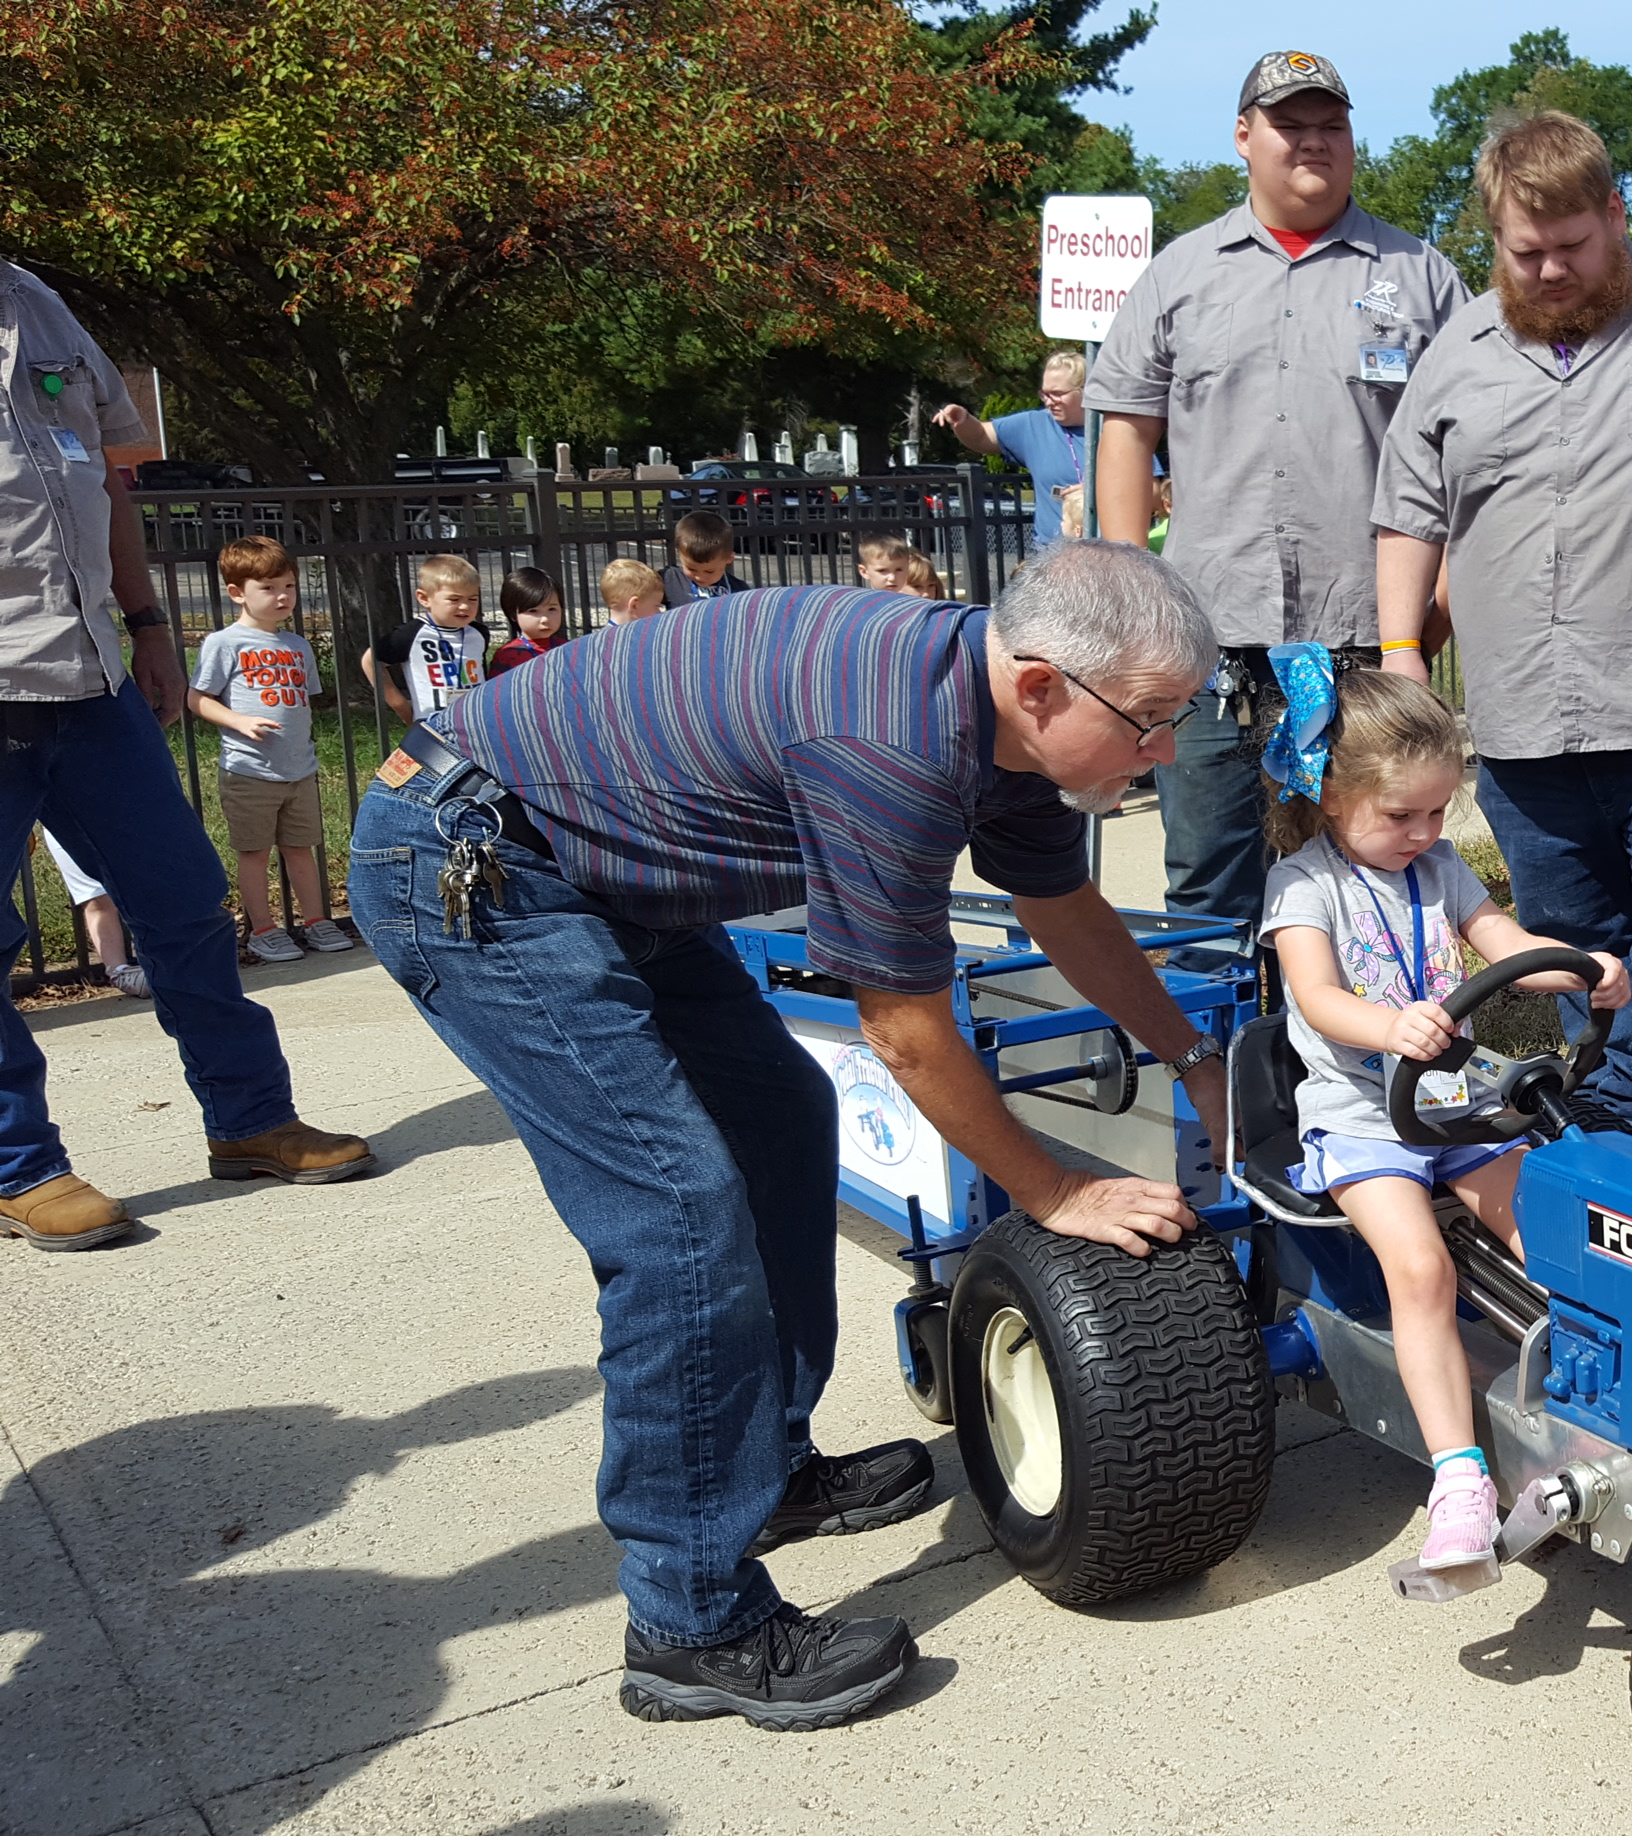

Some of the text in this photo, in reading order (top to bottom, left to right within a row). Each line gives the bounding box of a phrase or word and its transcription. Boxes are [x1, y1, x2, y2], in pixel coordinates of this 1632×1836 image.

[1047, 224, 1148, 258] Preschool
[1051, 278, 1128, 312] Entranc
[239, 649, 304, 669] MOM'S
[427, 659, 479, 688] EPIC
[260, 688, 307, 707] GUY
